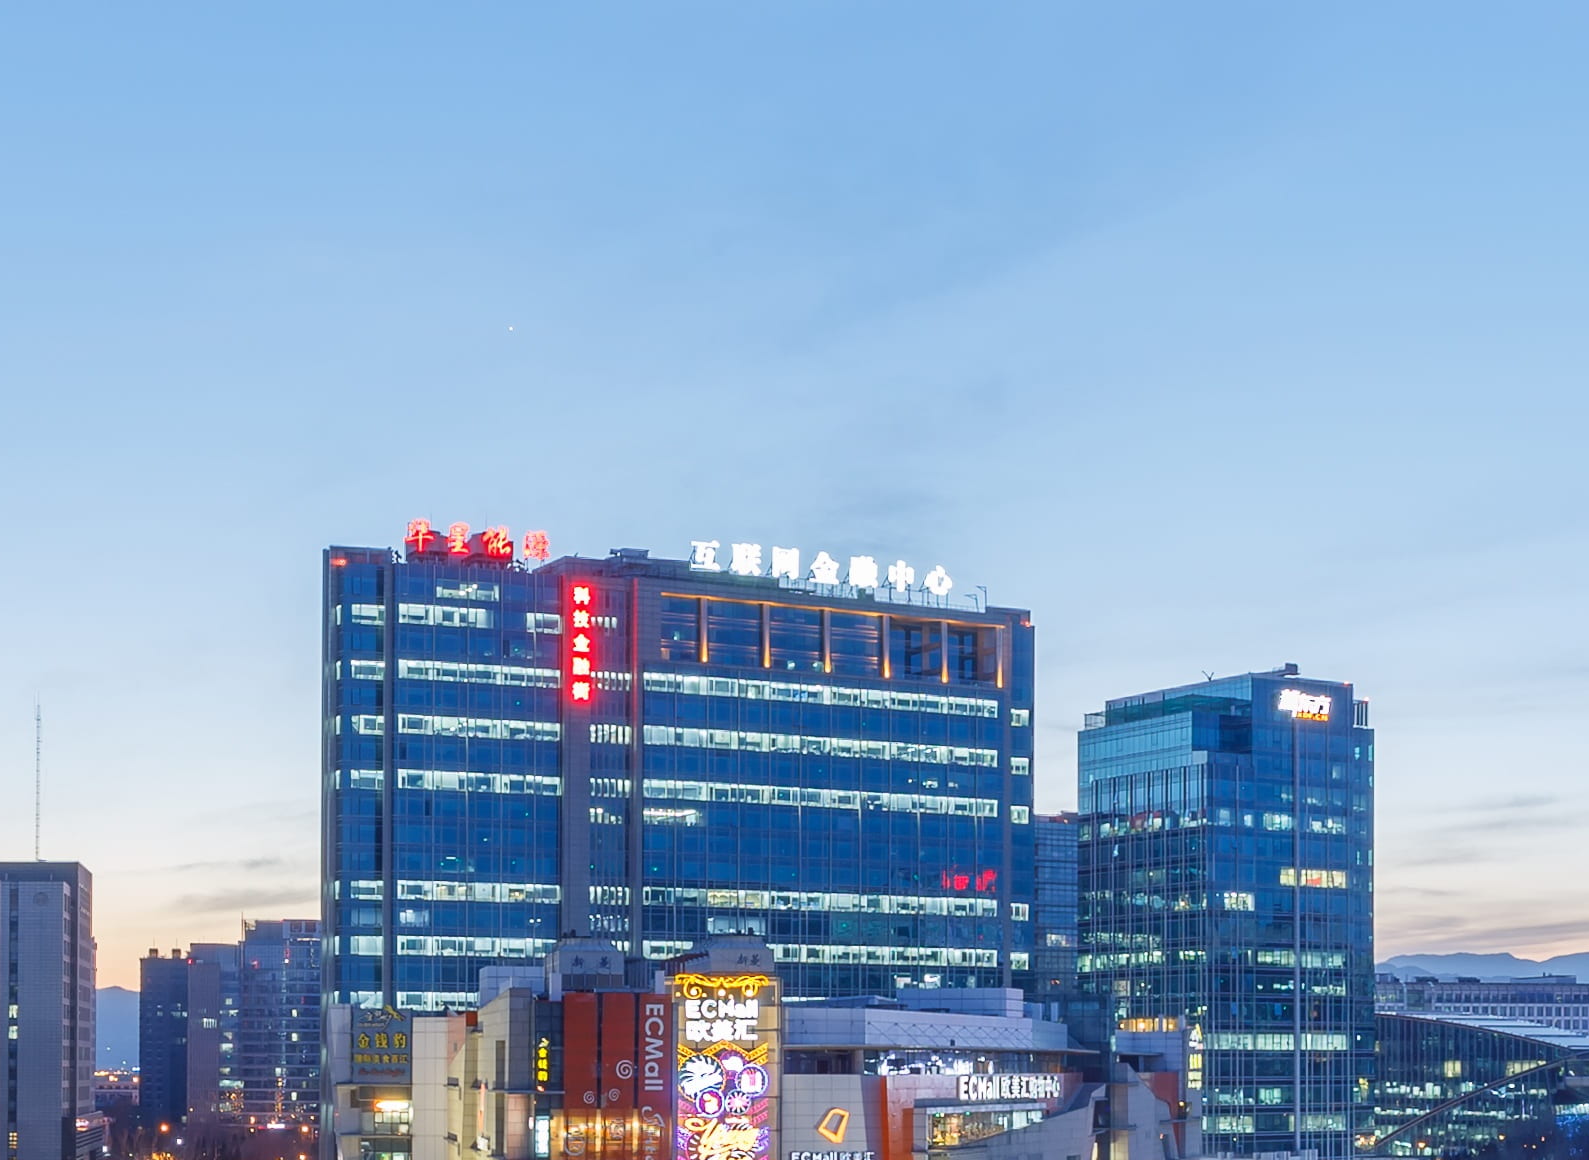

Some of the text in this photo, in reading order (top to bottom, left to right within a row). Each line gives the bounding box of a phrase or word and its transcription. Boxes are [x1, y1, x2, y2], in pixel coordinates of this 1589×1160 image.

[689, 540, 953, 596] 互联网金融中心
[684, 999, 759, 1019] ECMall
[357, 1033, 407, 1049] 金钱豹
[644, 1003, 664, 1091] ECMall
[959, 1075, 1000, 1100] ECMall
